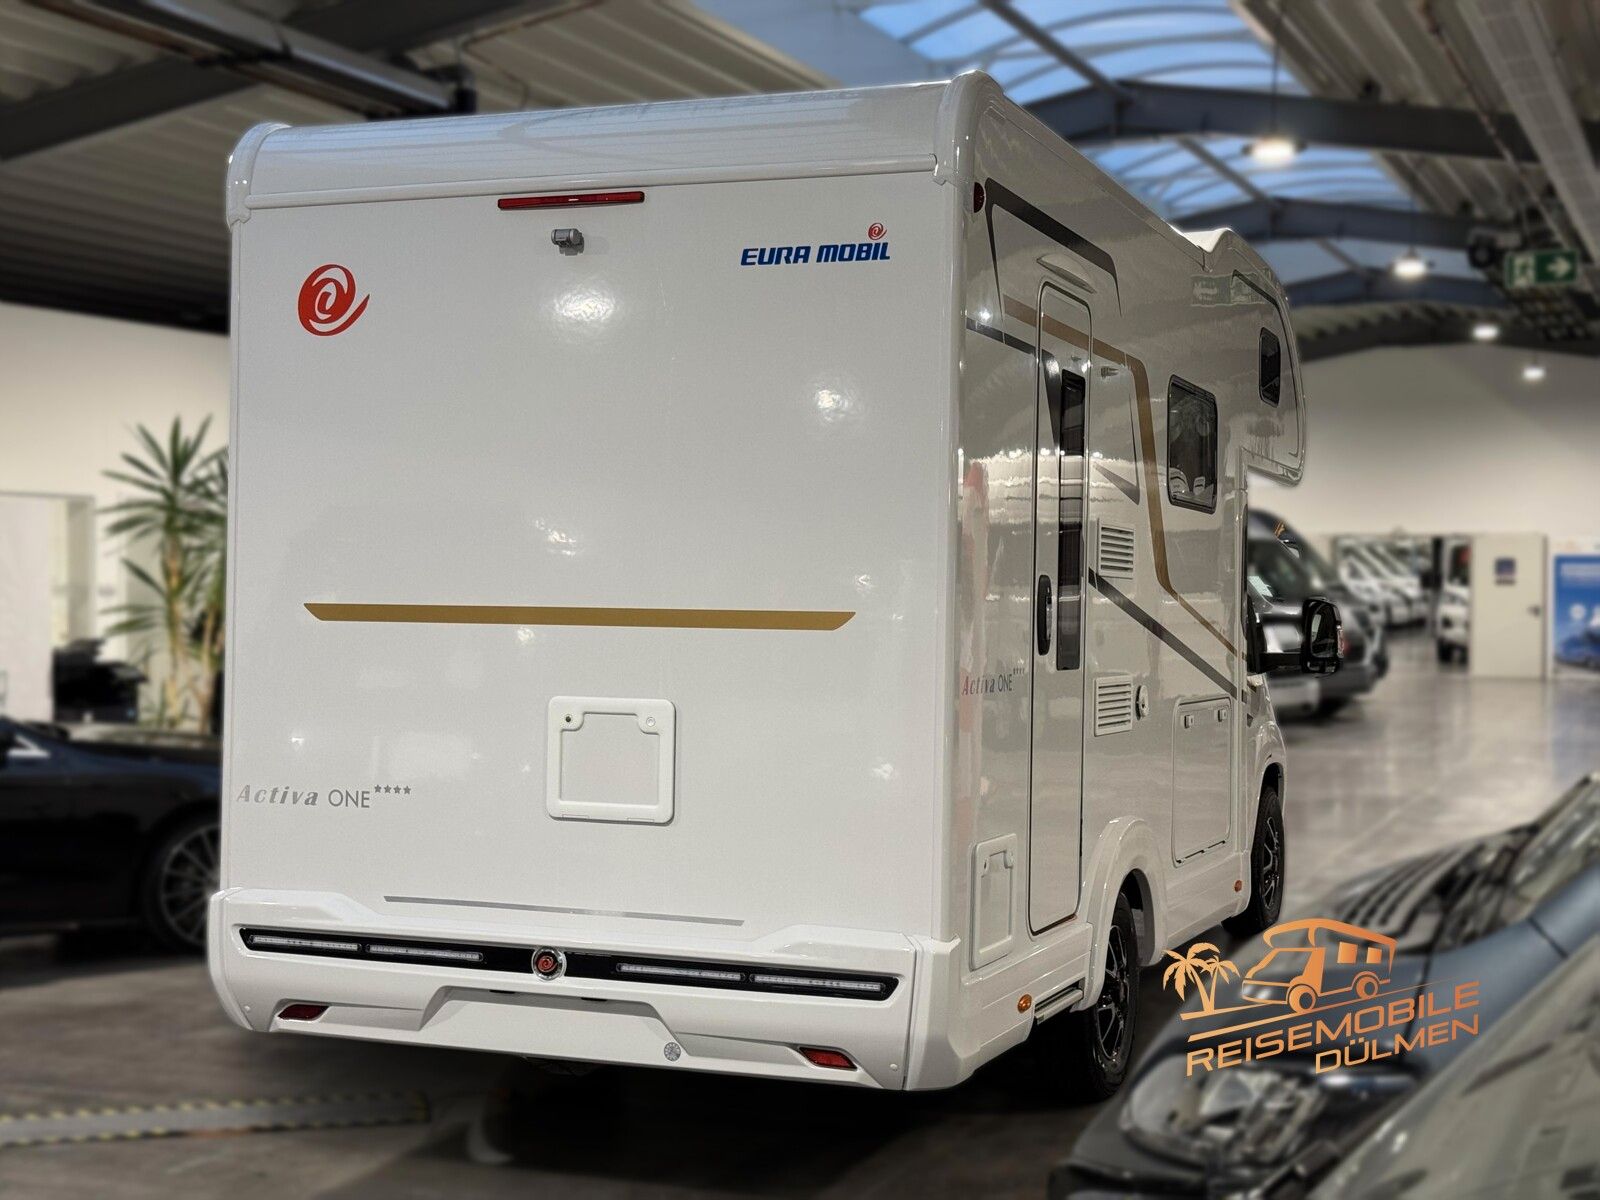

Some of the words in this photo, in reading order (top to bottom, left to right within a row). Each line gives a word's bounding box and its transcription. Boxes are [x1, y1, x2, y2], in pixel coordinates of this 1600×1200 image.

[740, 245, 811, 266] EURA
[816, 242, 890, 263] MOBIL
[961, 675, 995, 695] Activa
[236, 784, 319, 806] Activa
